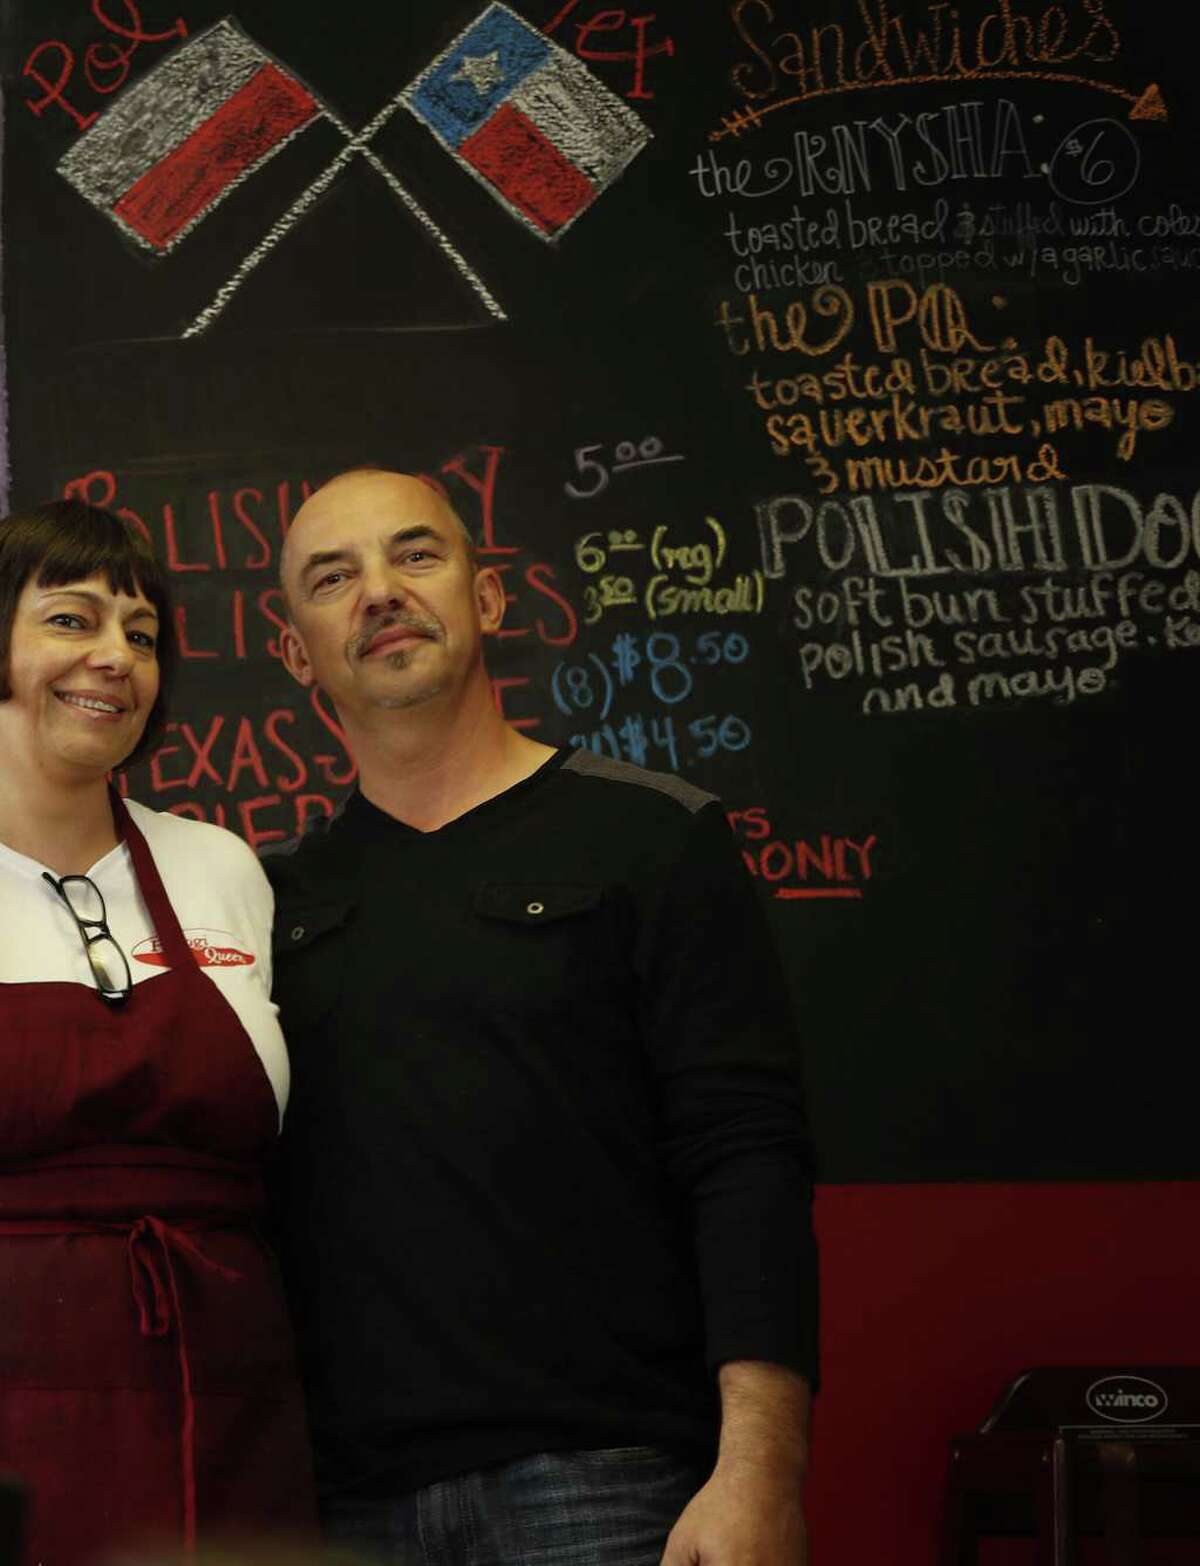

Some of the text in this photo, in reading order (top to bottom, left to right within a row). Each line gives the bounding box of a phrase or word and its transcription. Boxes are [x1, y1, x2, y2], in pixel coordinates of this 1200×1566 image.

[689, 149, 793, 198] the
[724, 204, 842, 257] toasted
[846, 197, 950, 250] bread
[734, 252, 847, 293] chicken
[714, 286, 854, 357] the
[745, 351, 917, 411] toasted
[1084, 332, 1200, 392] kielb
[1043, 394, 1176, 461] mayo
[846, 442, 1068, 491] mustard
[794, 577, 893, 630] soft
[900, 577, 1012, 629] bun
[801, 629, 947, 689] polish
[862, 664, 1107, 715] and mayo
